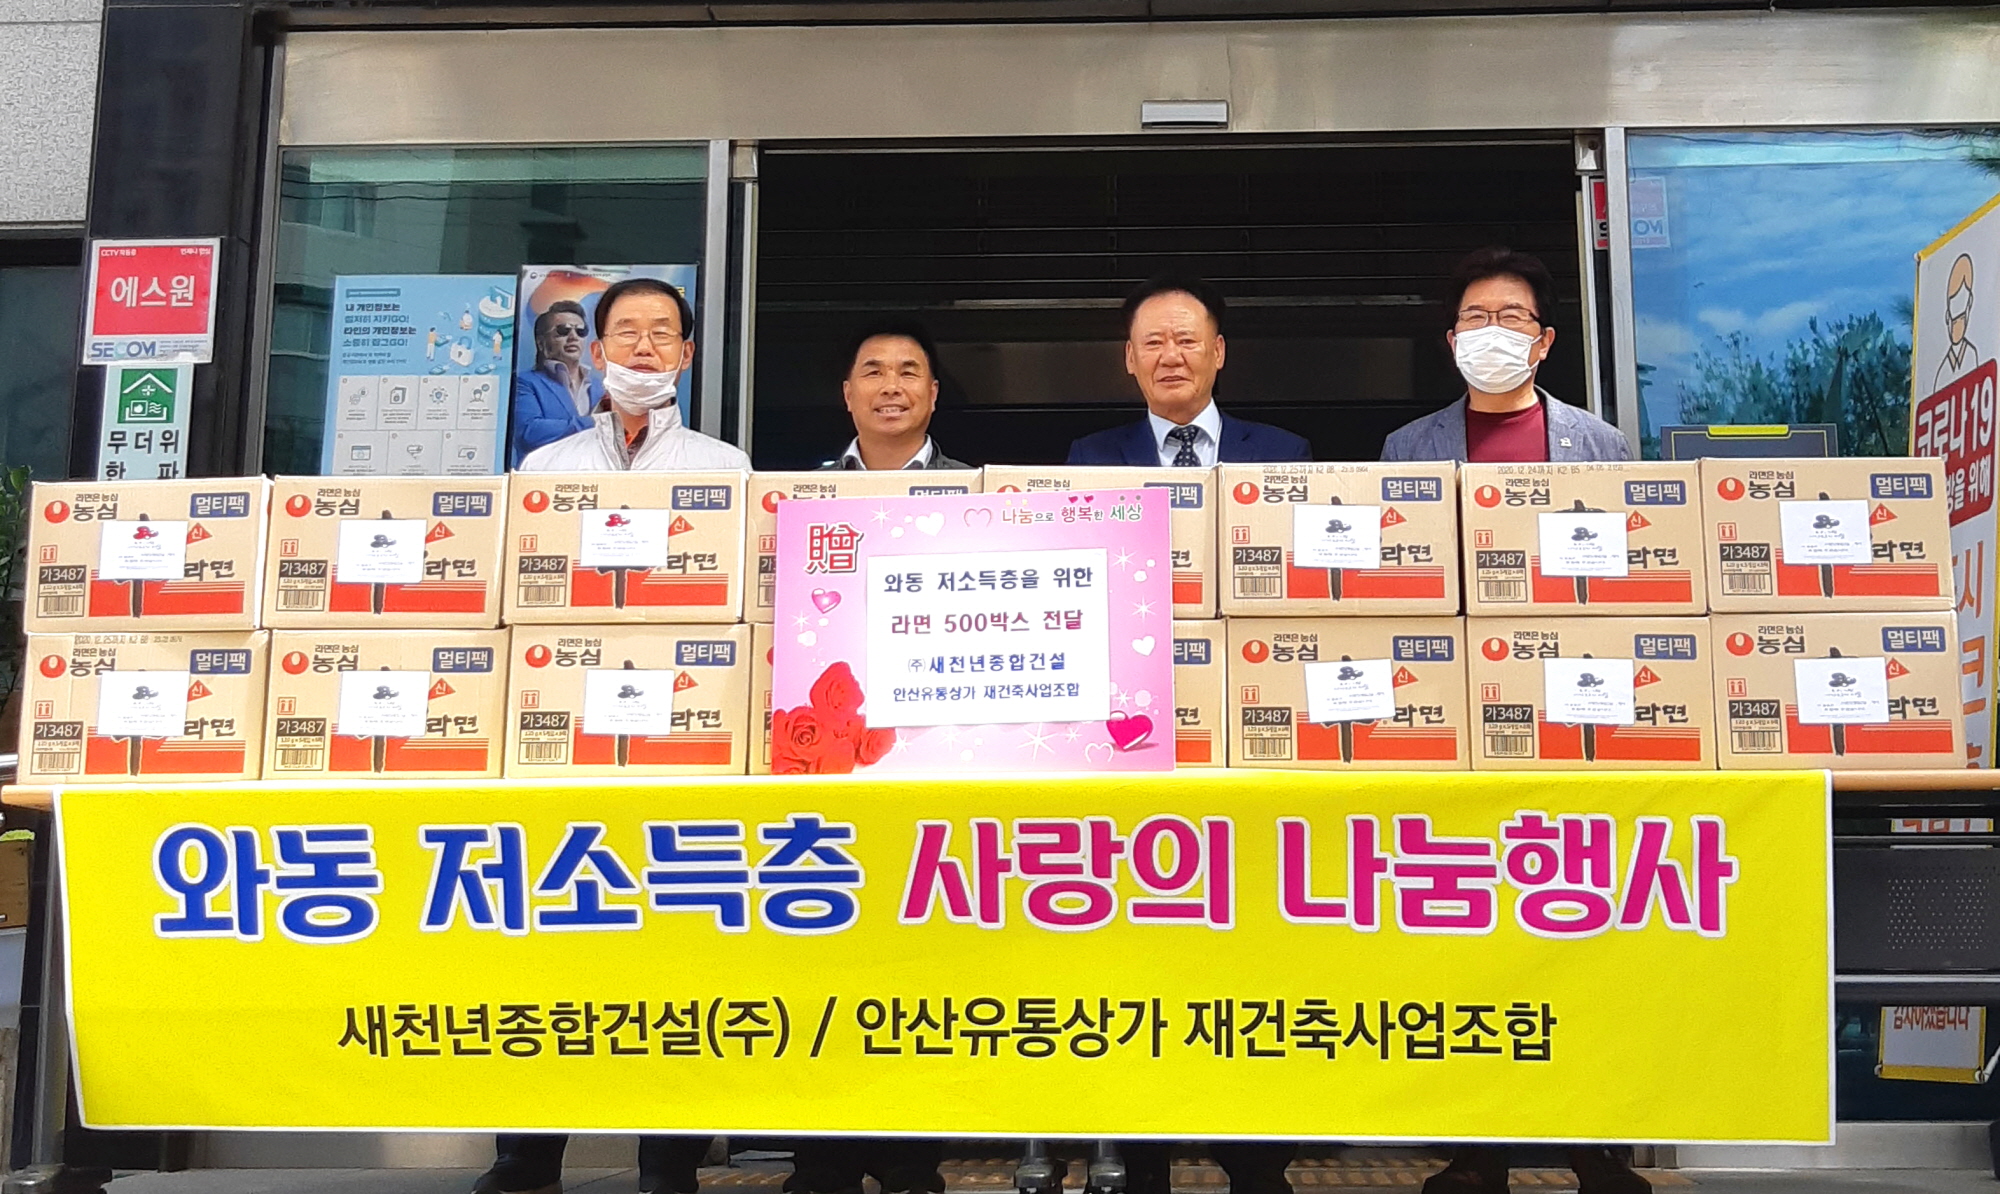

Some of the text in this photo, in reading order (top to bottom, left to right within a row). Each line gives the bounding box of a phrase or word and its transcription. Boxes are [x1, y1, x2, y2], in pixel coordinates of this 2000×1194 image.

[111, 276, 194, 307] 에스원
[357, 303, 399, 311] 개인정보는
[372, 327, 416, 335] 개인정보는
[91, 341, 156, 358] SECOM
[1918, 376, 1993, 463] 코로나19
[107, 430, 179, 454] 무더위
[1027, 479, 1070, 487] 라면은 농심
[1264, 476, 1307, 484] 라면은 농심
[1505, 479, 1530, 487] 라면은
[1750, 471, 1793, 479] 라면은 농심
[1969, 454, 1991, 502] 위해
[318, 489, 360, 497] 라면은 농심
[555, 484, 598, 492] 라면은 농심
[793, 484, 836, 492] 라면은 농심
[1170, 486, 1197, 504] 티팩
[1263, 485, 1308, 503] 농심
[1387, 481, 1437, 498] 멀티팩
[1630, 484, 1680, 501] 멀티팩
[1748, 481, 1794, 499] 농심
[1876, 477, 1926, 496] 멀티팩
[76, 494, 118, 502] 라면은 농심
[196, 496, 244, 514] 멀티팩
[438, 496, 486, 513] 멀티팩
[553, 494, 598, 511] 농심
[677, 489, 726, 506] 멀티팩
[1505, 489, 1550, 505] 농심
[73, 503, 118, 521] 농심
[314, 499, 360, 516] 농심
[1002, 505, 1142, 524] 나눔으로 행복한 세상
[1876, 508, 1887, 520] 신
[1386, 511, 1396, 523] 신
[1630, 515, 1641, 527] 신
[191, 528, 202, 539] 신
[435, 527, 444, 537] 신
[673, 520, 684, 532] 신
[1171, 550, 1192, 567] 면
[1235, 550, 1279, 562] 가3487
[1381, 544, 1433, 565] 라면
[1479, 553, 1523, 566] 가3487
[1628, 547, 1679, 568] 라면
[1722, 546, 1767, 558] 가3487
[1873, 540, 1926, 562] 라면
[186, 560, 235, 581] 라면
[281, 563, 325, 575] 가3487
[426, 558, 477, 580] 라면
[521, 558, 565, 570] 가3487
[668, 552, 718, 574] 라면
[41, 569, 84, 580] 가3487
[884, 567, 1093, 592] 와동 저소득층을 위한
[892, 610, 1083, 634] 라면 500박스 전달
[1758, 626, 1803, 634] 라면은 농심
[558, 639, 602, 647] 라면은 농심
[1274, 634, 1318, 642] 라면은 농심
[1513, 632, 1558, 640] 라면은 농심
[1888, 631, 1940, 649] 멀티팩
[73, 648, 116, 657] 라면은 농심
[315, 645, 359, 653] 라면은 농심
[681, 644, 731, 662] 멀티팩
[1174, 642, 1205, 661] 티팩
[1273, 644, 1318, 662] 농심
[1398, 639, 1448, 658] 멀티팩
[1513, 641, 1559, 659] 농심
[1640, 638, 1691, 656] 멀티팩
[1757, 636, 1805, 654] 농심
[196, 653, 246, 670] 멀티팩
[312, 655, 358, 673] 농심
[439, 651, 488, 669] 멀티팩
[555, 649, 601, 667] 농심
[69, 658, 115, 677] 농심
[1640, 670, 1650, 682] 신
[1888, 663, 1899, 675] 신
[677, 676, 688, 687] 신
[1397, 671, 1408, 683] 신
[192, 685, 202, 697] 신
[435, 683, 446, 695] 신
[894, 683, 1079, 702] 안산유통상가 재건축사업조합
[1245, 710, 1289, 722] 가3487
[1393, 704, 1445, 727] 라면
[1485, 707, 1531, 720] 가3487
[1635, 703, 1688, 725] 라면
[1732, 702, 1777, 716] 가3487
[1889, 696, 1939, 719] 라면
[522, 715, 567, 727] 가3487
[671, 709, 722, 731] 라면
[1175, 707, 1200, 726] 면
[36, 725, 80, 737] 가3487
[185, 718, 235, 739] 라면
[279, 720, 324, 733] 가3487
[428, 715, 479, 736] 라면
[154, 810, 1738, 943] 와동 저소득층 사랑의 나눔행사
[338, 996, 1557, 1061] 새천년종합건설(주) / 안산유통상가 재건축사업조합
